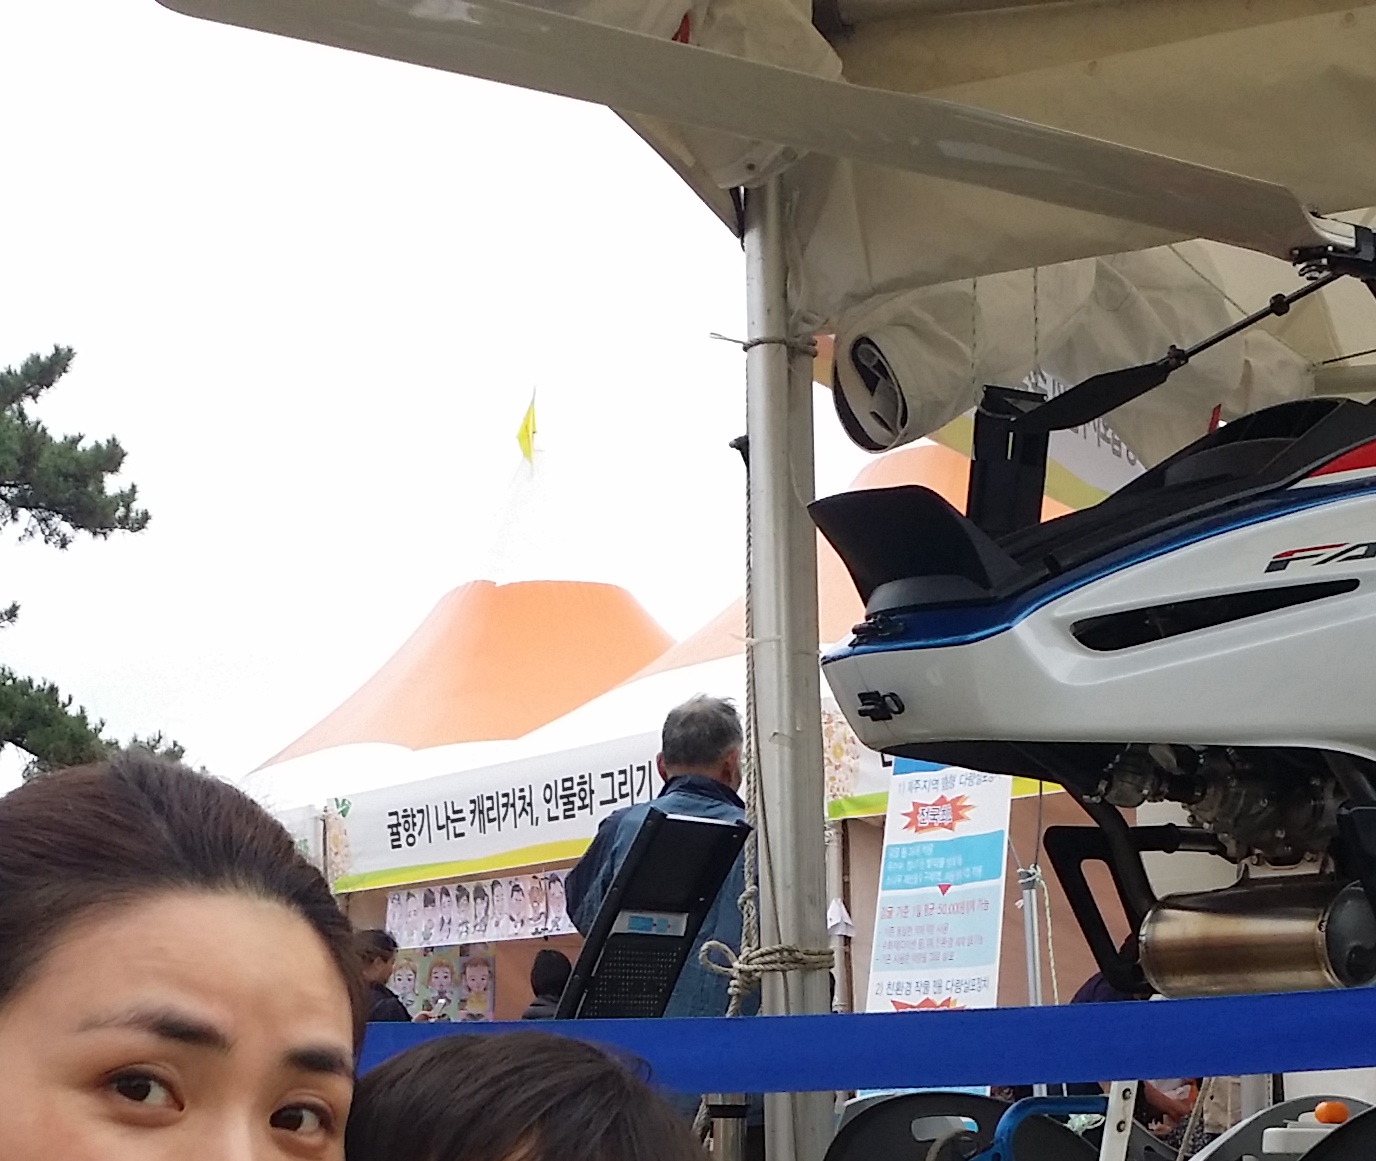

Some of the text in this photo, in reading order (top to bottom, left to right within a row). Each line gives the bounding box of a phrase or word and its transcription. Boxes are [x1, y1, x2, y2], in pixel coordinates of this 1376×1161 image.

[387, 759, 655, 850] 귤향기 나는 캐리커처, 인물화 그리기
[875, 982, 883, 995] 2)
[885, 980, 912, 996] 친환경
